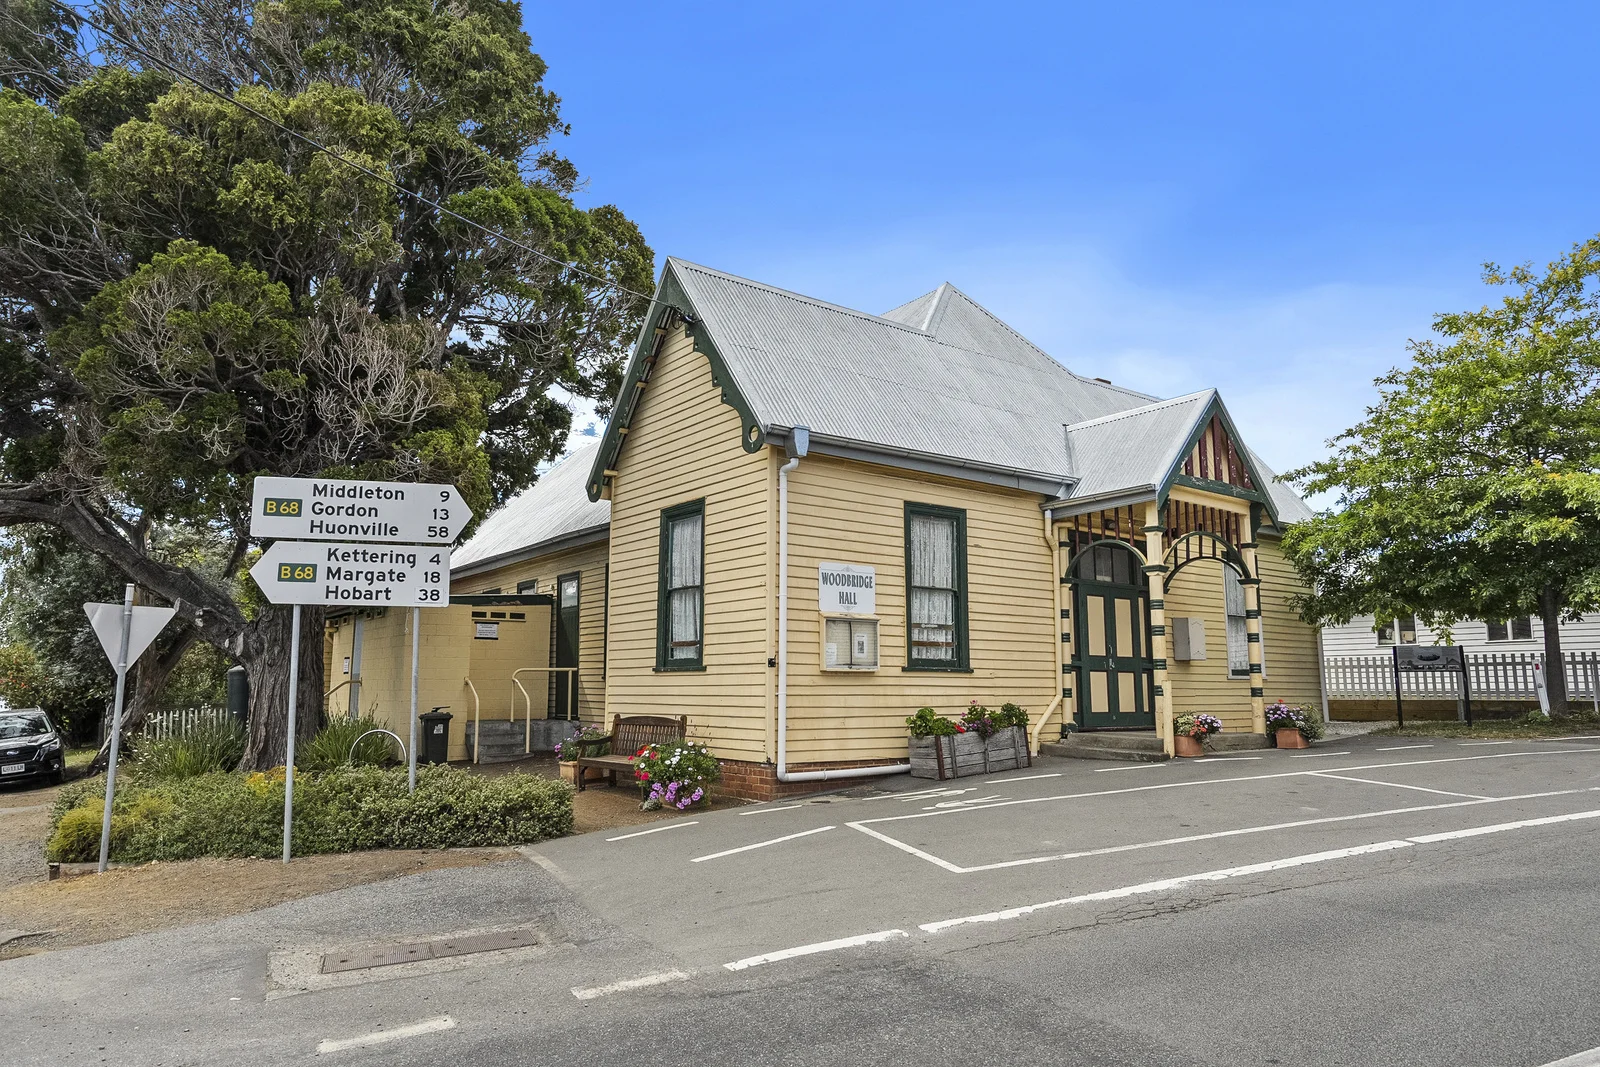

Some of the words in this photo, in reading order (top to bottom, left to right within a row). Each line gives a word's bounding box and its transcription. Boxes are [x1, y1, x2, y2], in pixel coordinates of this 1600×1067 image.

[313, 484, 405, 500] Middleton
[440, 491, 450, 502] 9
[311, 502, 378, 517] Gordon
[433, 508, 449, 520] 13
[310, 520, 399, 536] Huonville
[428, 526, 449, 538] 58
[327, 548, 416, 568] Kettering
[429, 553, 441, 565] 4
[326, 567, 406, 586] Margate
[424, 571, 440, 583] 18
[821, 572, 873, 588] WOODBRIDGE
[325, 586, 392, 600] Hobart
[418, 589, 440, 601] 38
[839, 591, 857, 605] HALL
